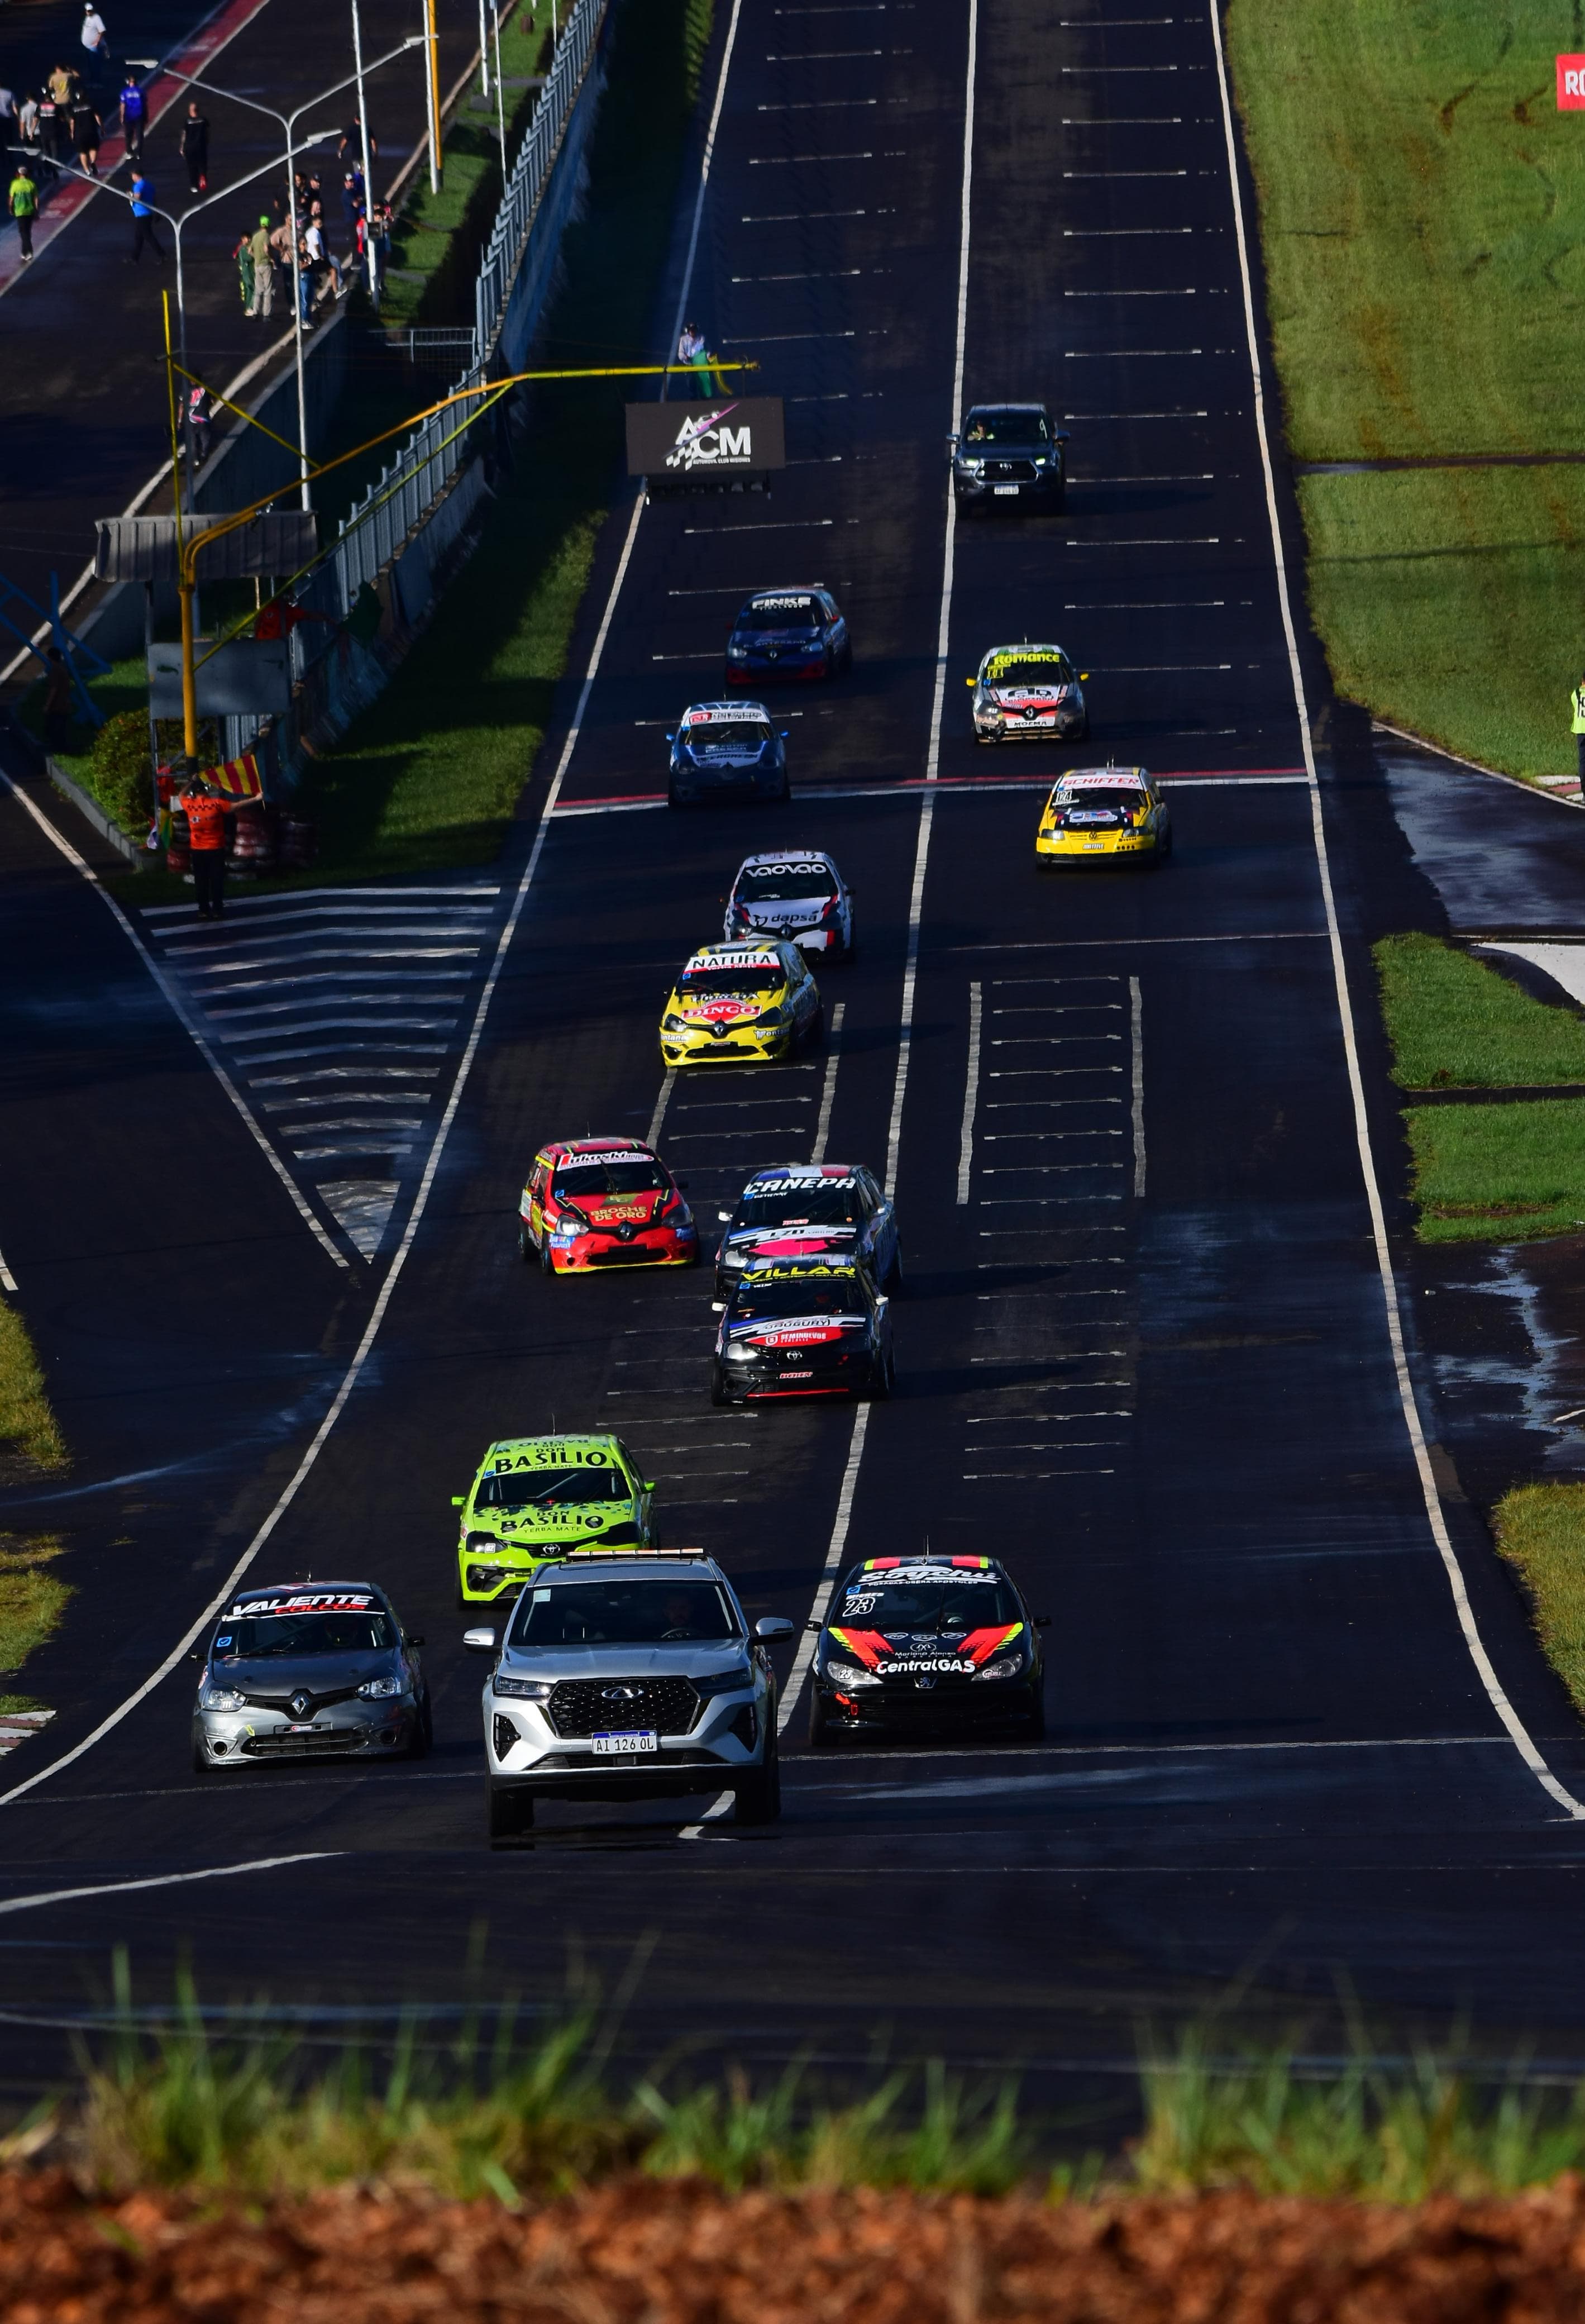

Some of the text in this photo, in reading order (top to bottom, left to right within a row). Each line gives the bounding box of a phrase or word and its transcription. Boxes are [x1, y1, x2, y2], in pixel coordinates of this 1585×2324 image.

[675, 416, 751, 459] ACM
[1039, 418, 1048, 440] 9
[1056, 790, 1072, 803] 124
[693, 955, 771, 969] NATURA
[688, 1006, 755, 1017] DINCO
[743, 1177, 856, 1194] CANEPA
[591, 1207, 647, 1216] BROCHE
[742, 1266, 855, 1280] VILLAR
[495, 1451, 607, 1474] BASILIO
[500, 1515, 604, 1534] BASILIO
[233, 1595, 374, 1616] VALIENTE
[842, 1597, 876, 1617] 23
[597, 1740, 610, 1751] AI
[615, 1739, 636, 1750] 126
